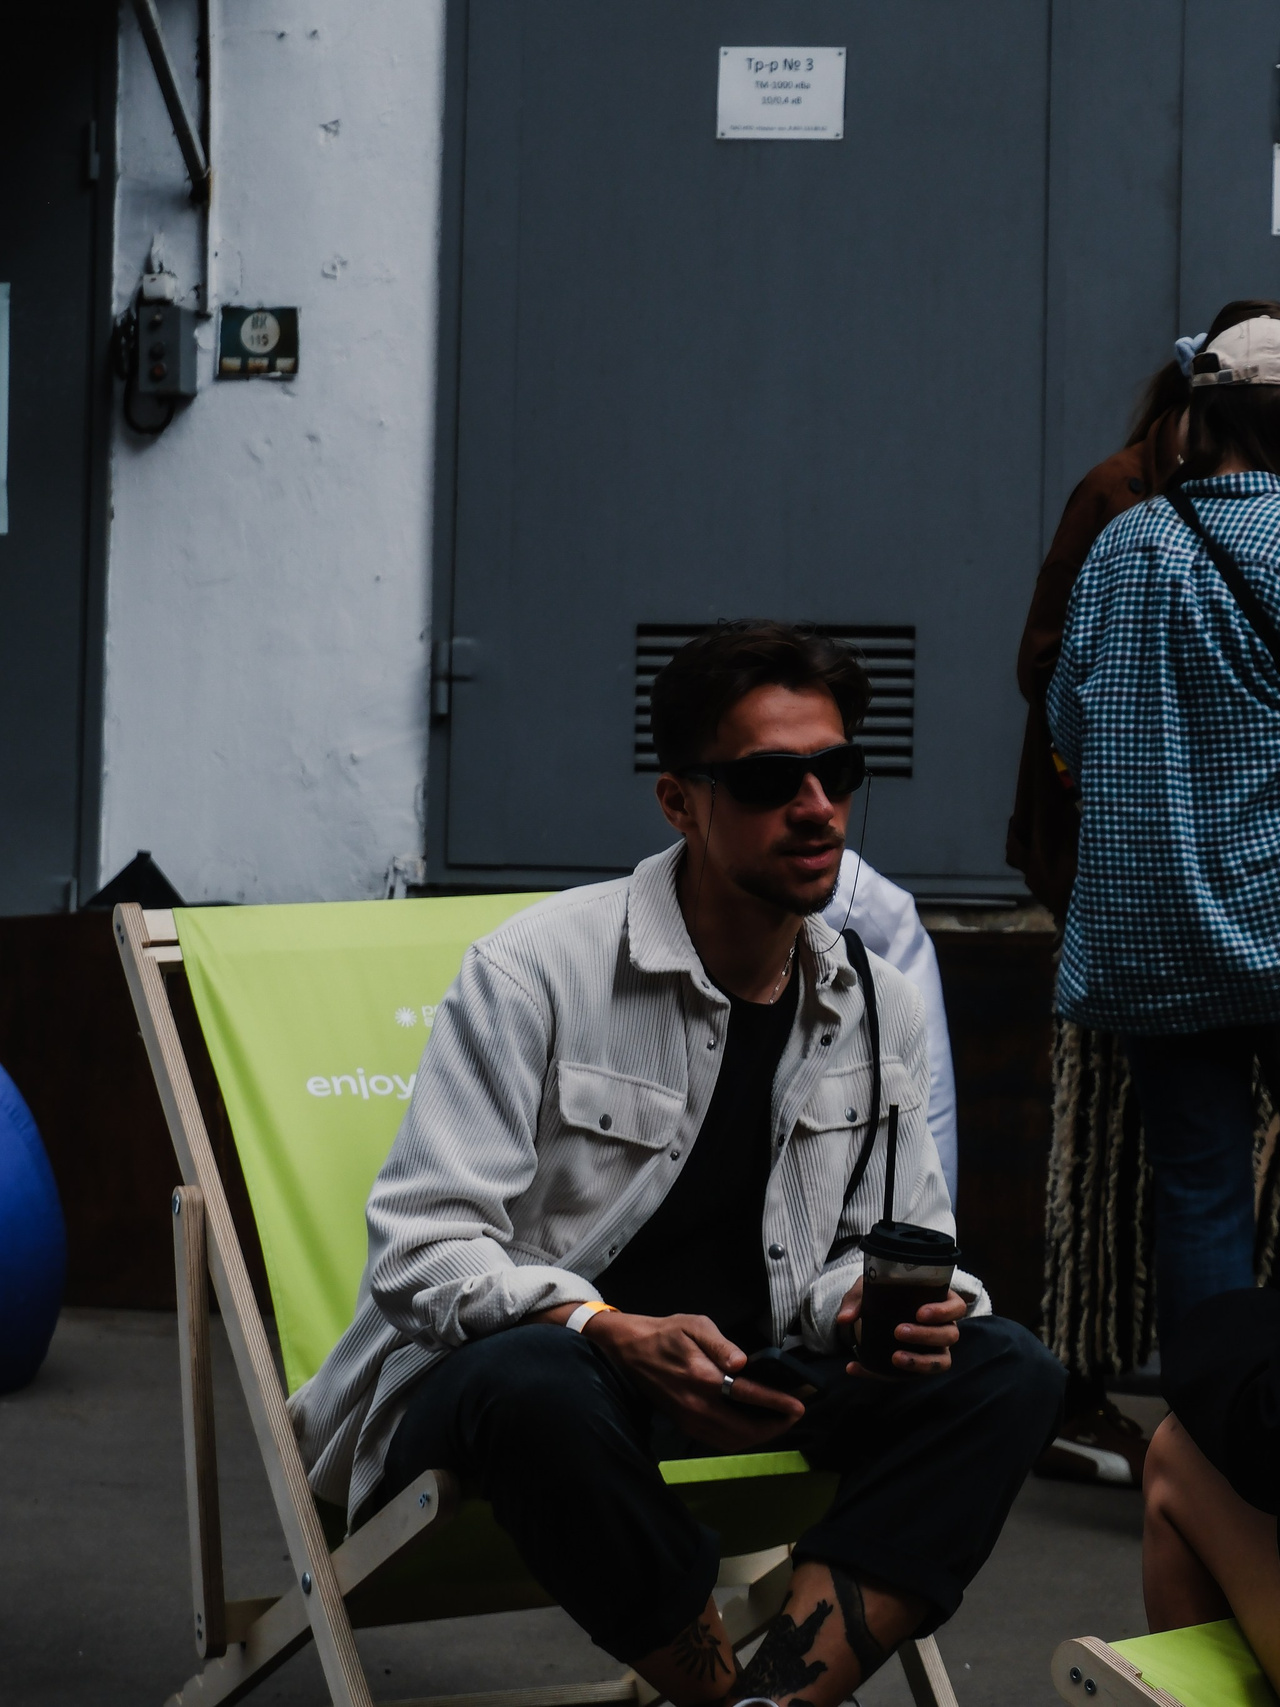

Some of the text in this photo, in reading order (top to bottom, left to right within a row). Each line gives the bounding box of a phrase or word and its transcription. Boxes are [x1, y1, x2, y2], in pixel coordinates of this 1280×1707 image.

[746, 57, 815, 73] Тр-р № 3
[306, 1067, 417, 1100] enjoy
